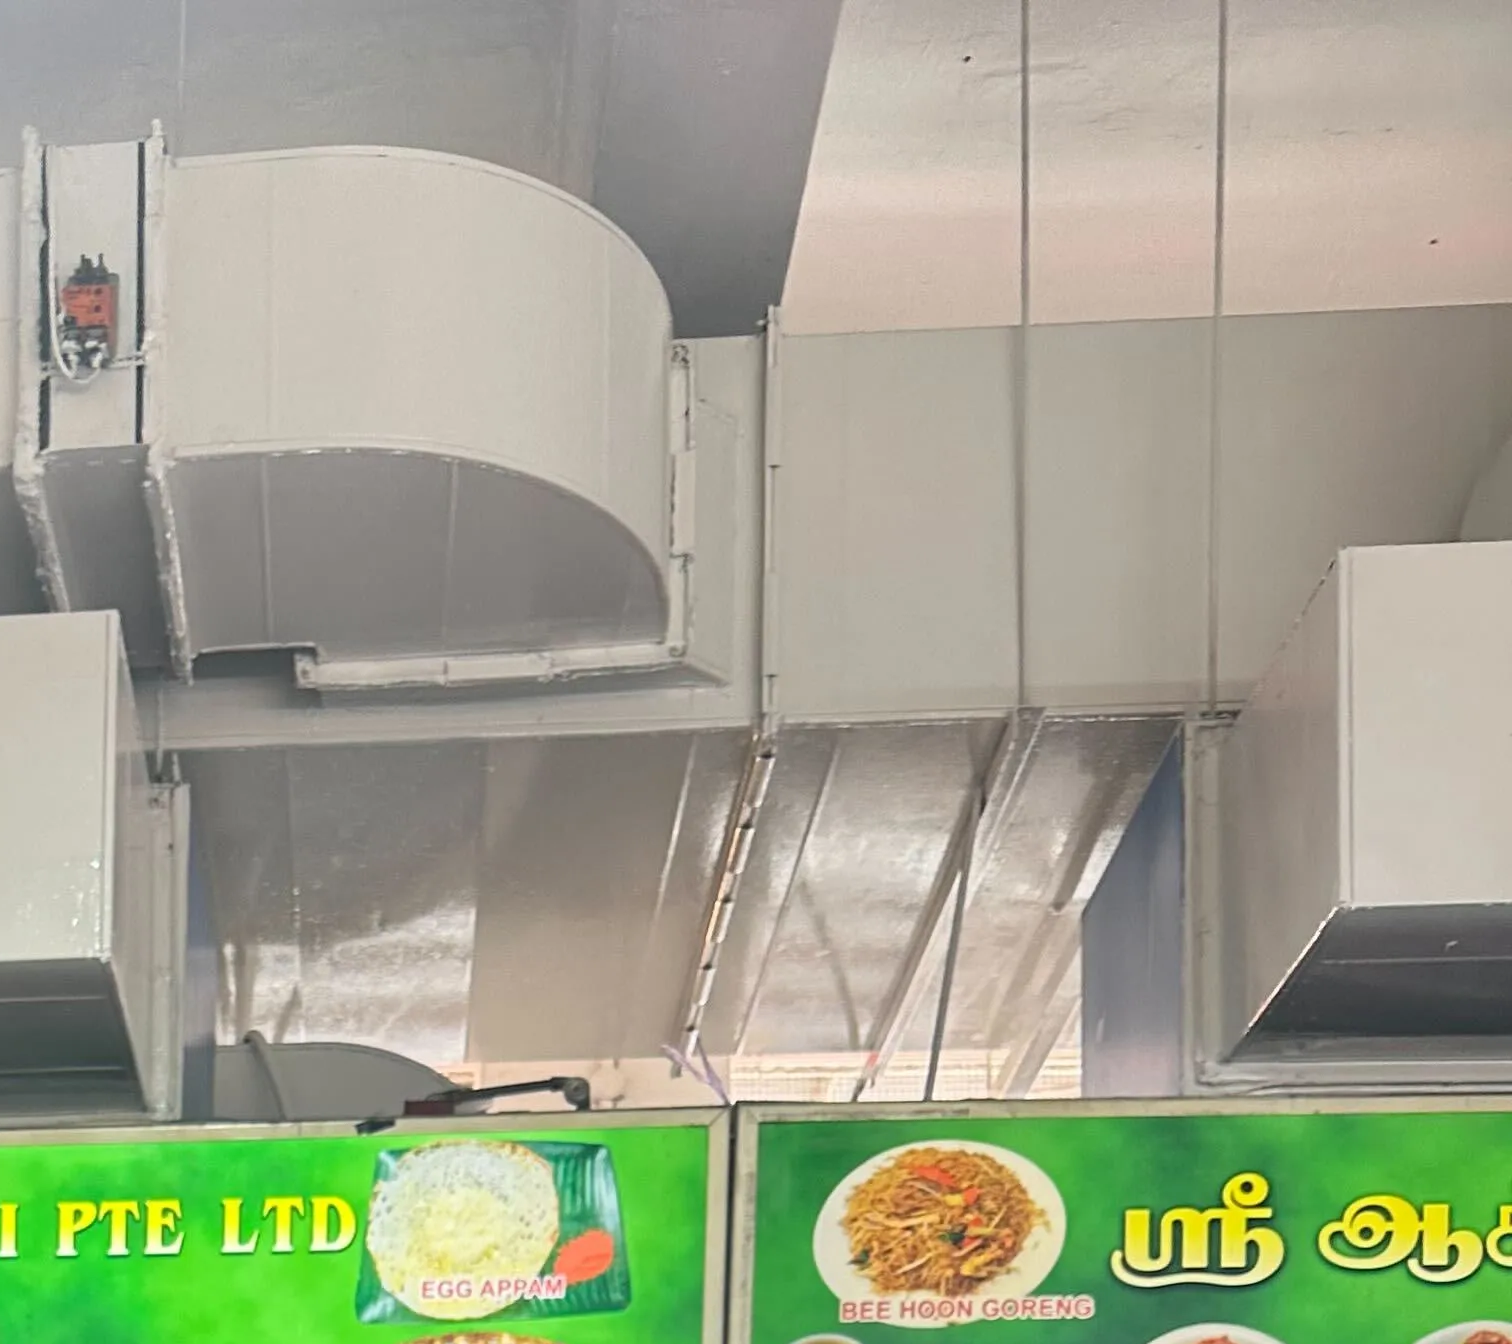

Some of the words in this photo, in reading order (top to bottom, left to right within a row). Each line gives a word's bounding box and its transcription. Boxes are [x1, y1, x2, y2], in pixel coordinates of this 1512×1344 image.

[54, 1199, 185, 1258] PTE
[219, 1195, 357, 1256] LTD
[1318, 1195, 1512, 1283] ஆ
[421, 1280, 472, 1298] EGG
[480, 1278, 564, 1298] APPAM
[842, 1300, 892, 1320] BEE
[899, 1299, 973, 1320] HOON
[981, 1297, 1093, 1318] GORENG
